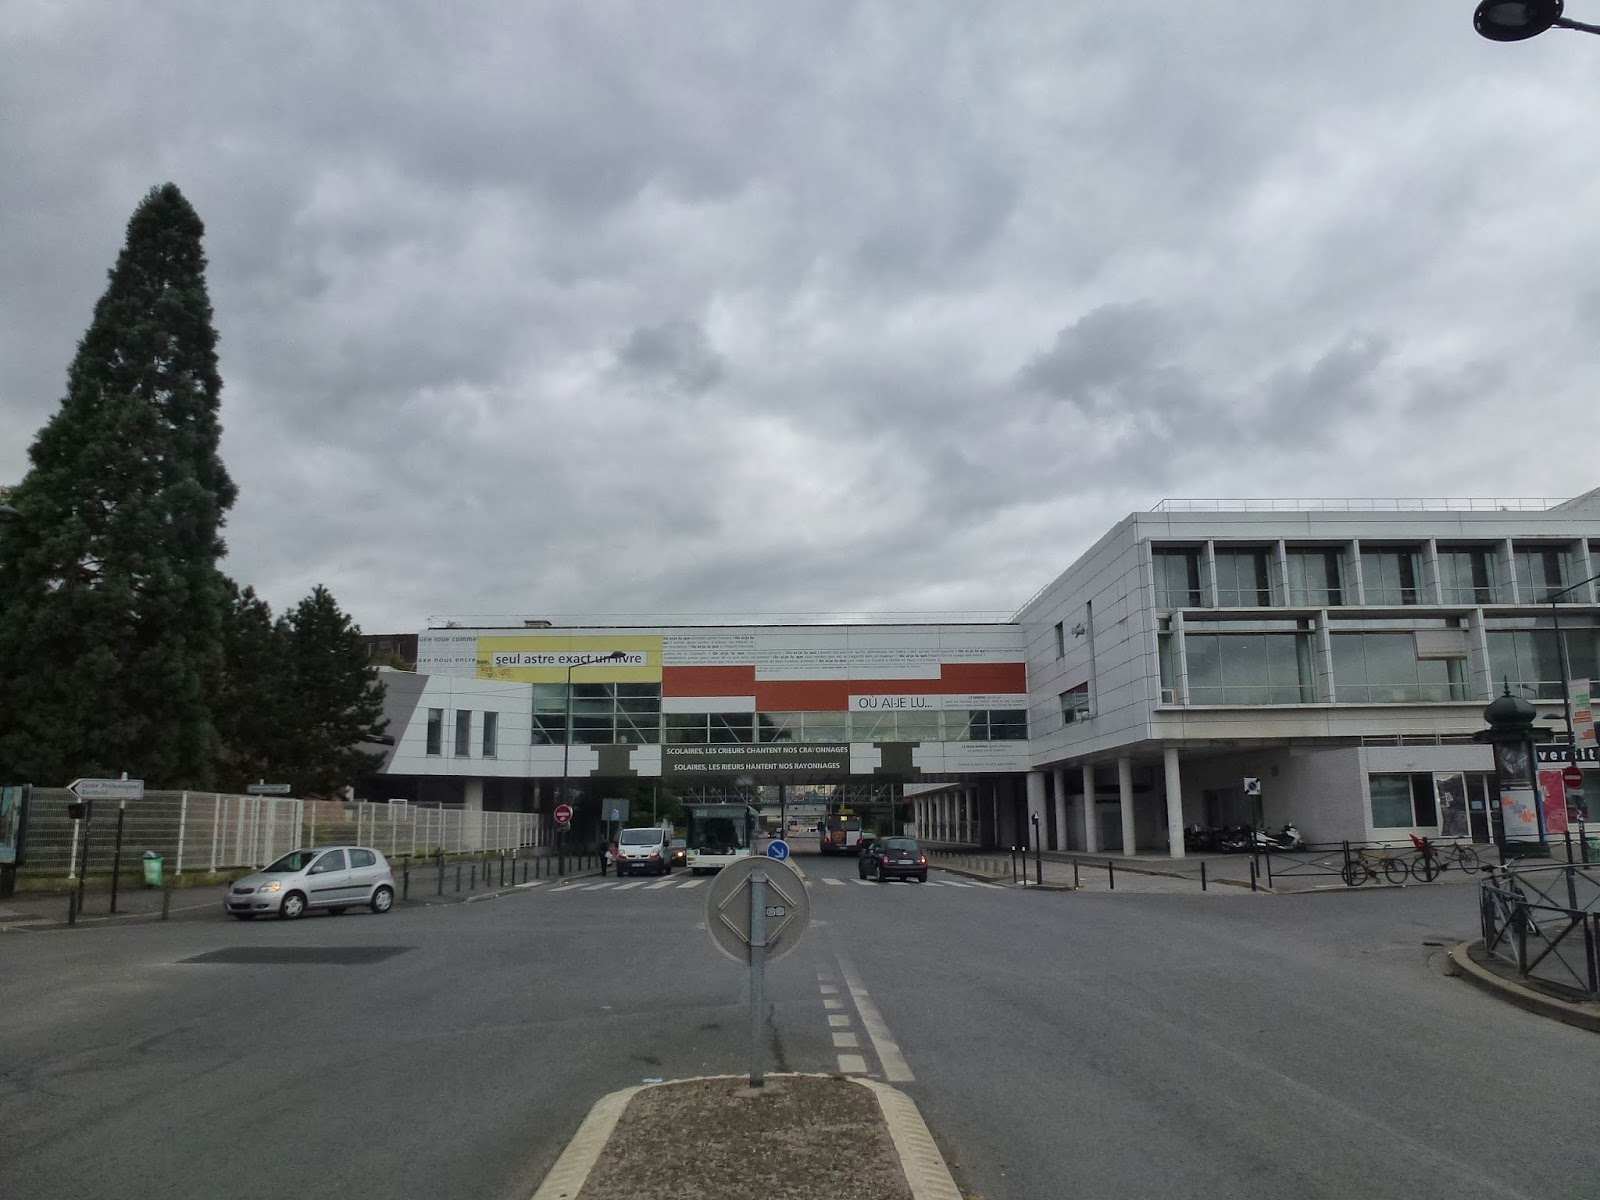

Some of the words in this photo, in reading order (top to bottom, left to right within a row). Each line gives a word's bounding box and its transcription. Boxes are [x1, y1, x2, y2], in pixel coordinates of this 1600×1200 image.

[495, 653, 521, 665] seul
[524, 654, 555, 664] astre
[558, 654, 592, 664] exact
[858, 695, 878, 708] OÙ
[881, 697, 906, 708] AI-JE
[910, 697, 933, 708] LU...
